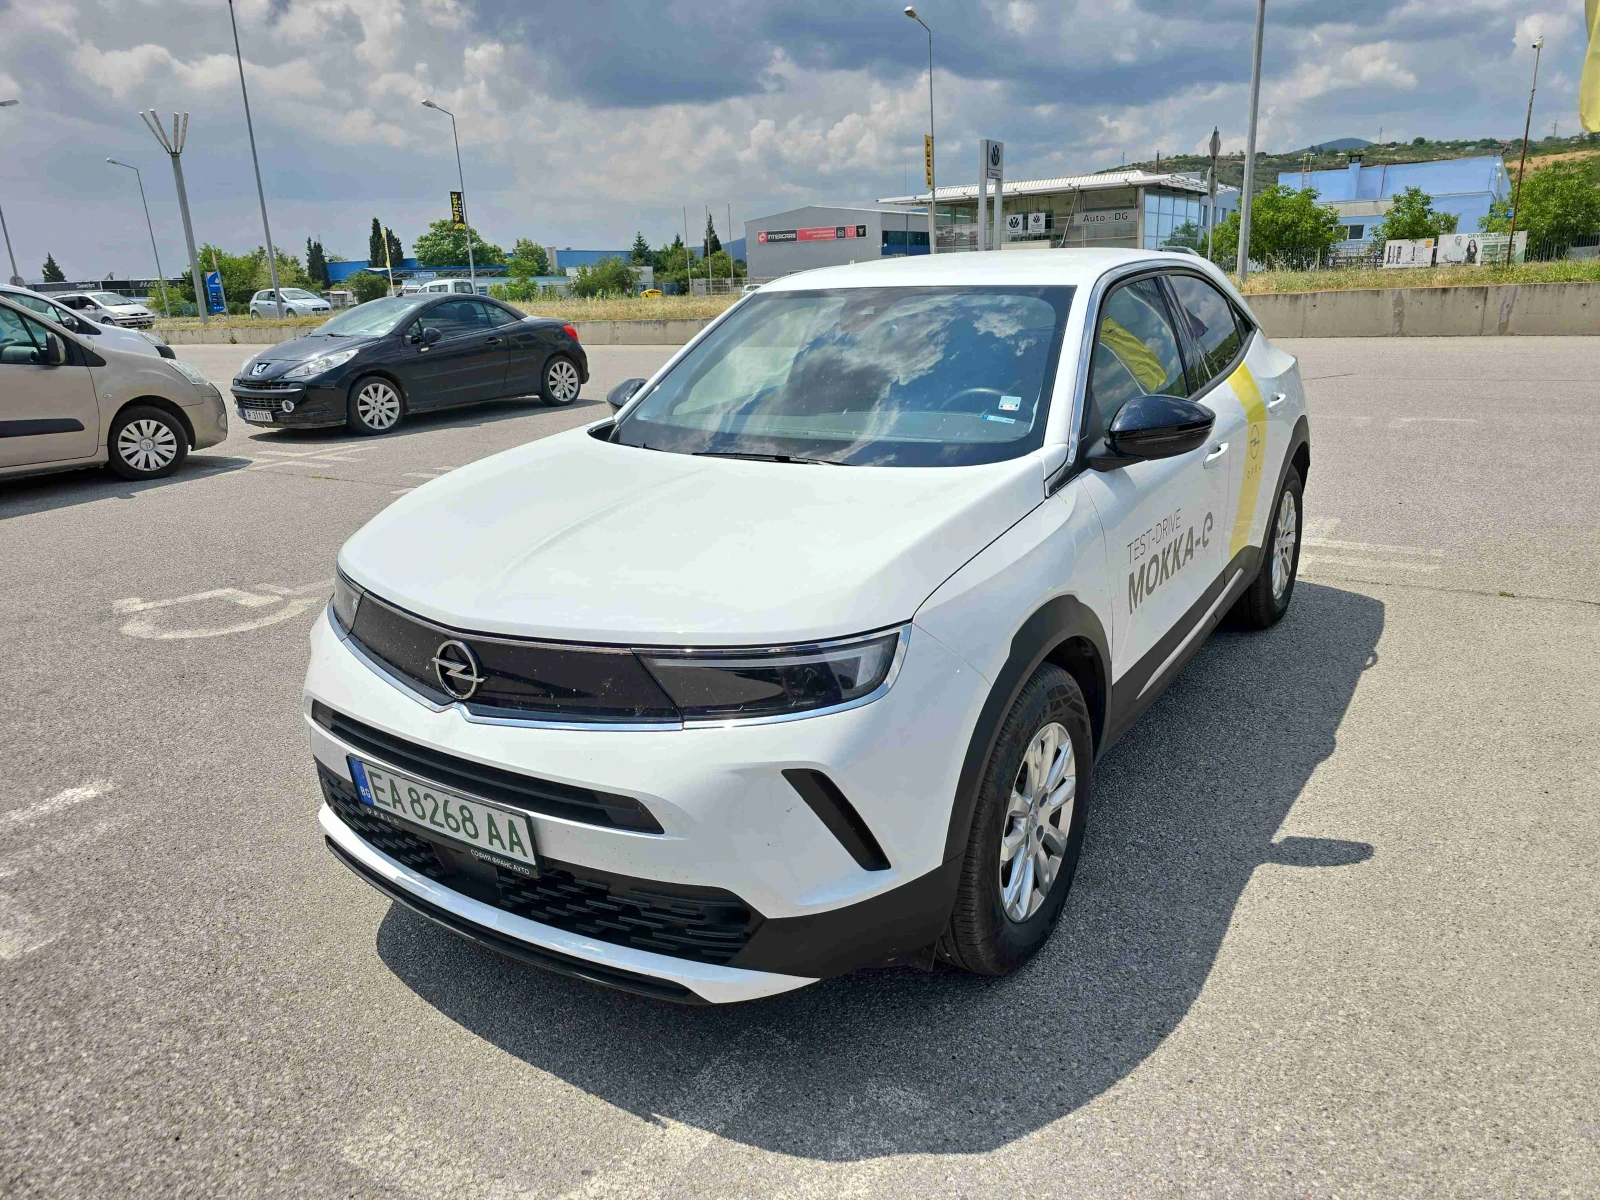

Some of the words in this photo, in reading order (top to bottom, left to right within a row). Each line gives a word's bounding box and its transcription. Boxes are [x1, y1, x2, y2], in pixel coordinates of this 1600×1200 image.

[1083, 214, 1105, 223] Auto
[1114, 211, 1128, 221] DG
[1127, 508, 1181, 564] TEST-DRIVE
[360, 785, 371, 799] BG
[367, 770, 408, 815] EA
[407, 786, 480, 840] 8268
[486, 812, 529, 858] AA
[470, 849, 492, 862] СОФИЯ
[491, 856, 513, 869] ФРАНС
[513, 864, 530, 875] АУТО
